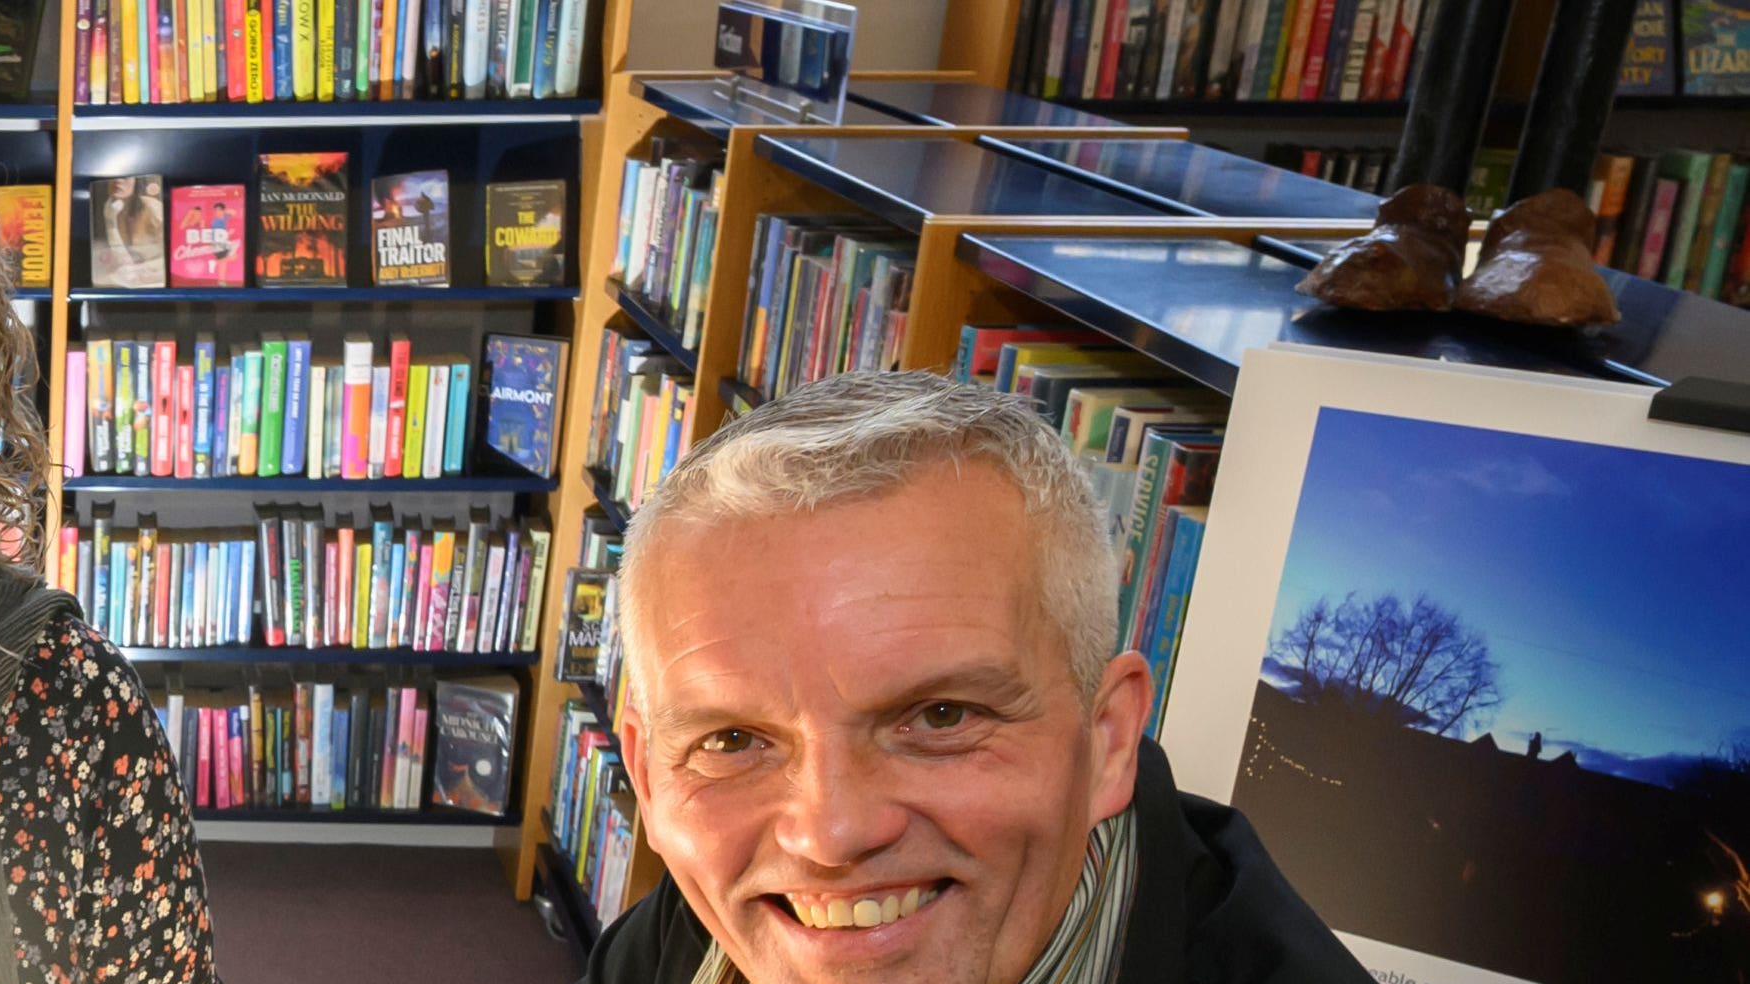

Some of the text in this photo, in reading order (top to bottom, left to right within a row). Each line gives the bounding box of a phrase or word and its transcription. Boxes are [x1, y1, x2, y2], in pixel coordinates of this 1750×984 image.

[260, 215, 345, 232] WILDING
[377, 225, 423, 249] FINAL
[494, 226, 560, 248] COWARD
[377, 242, 446, 267] TRAITOR
[1130, 453, 1160, 544] SERVICE
